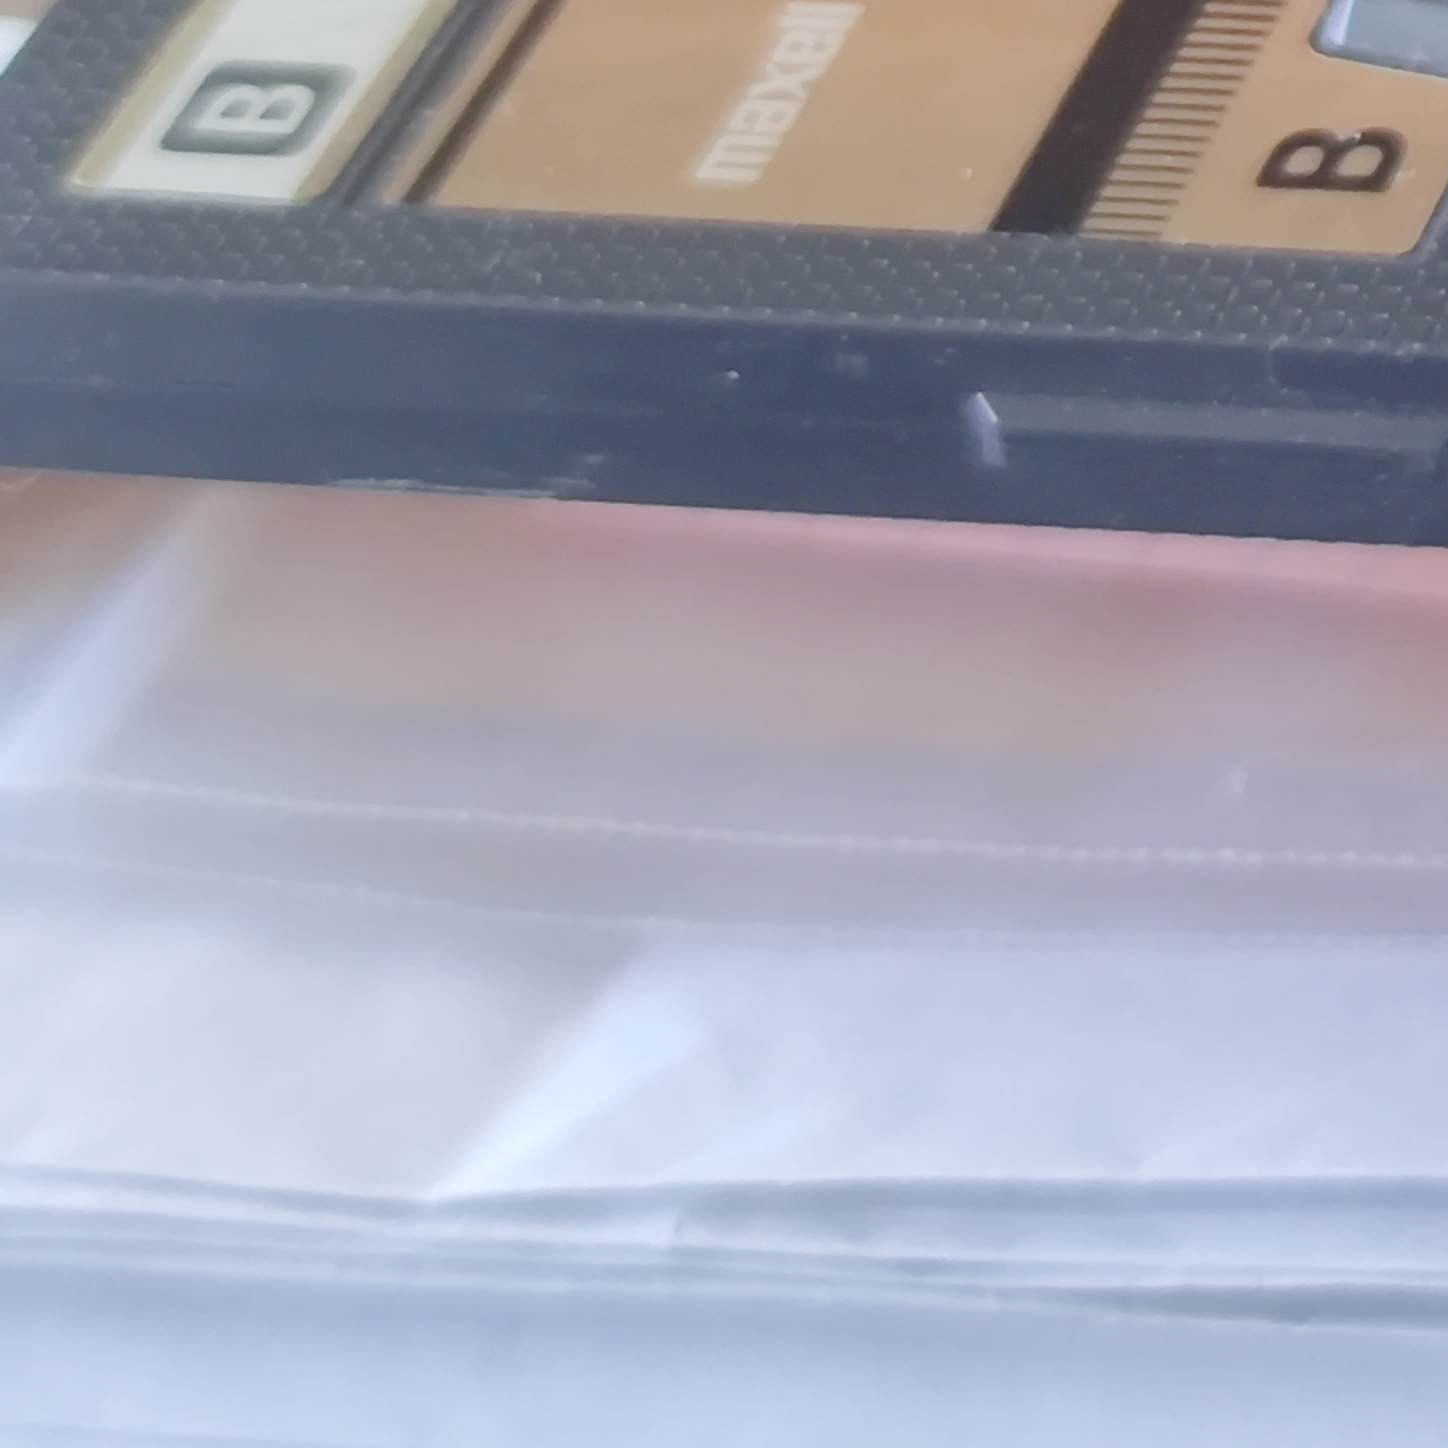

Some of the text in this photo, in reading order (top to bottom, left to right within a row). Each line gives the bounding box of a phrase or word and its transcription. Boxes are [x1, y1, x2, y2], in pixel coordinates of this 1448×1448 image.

[193, 80, 316, 137] B
[696, 1, 865, 182] maxell
[1256, 127, 1408, 193] B
